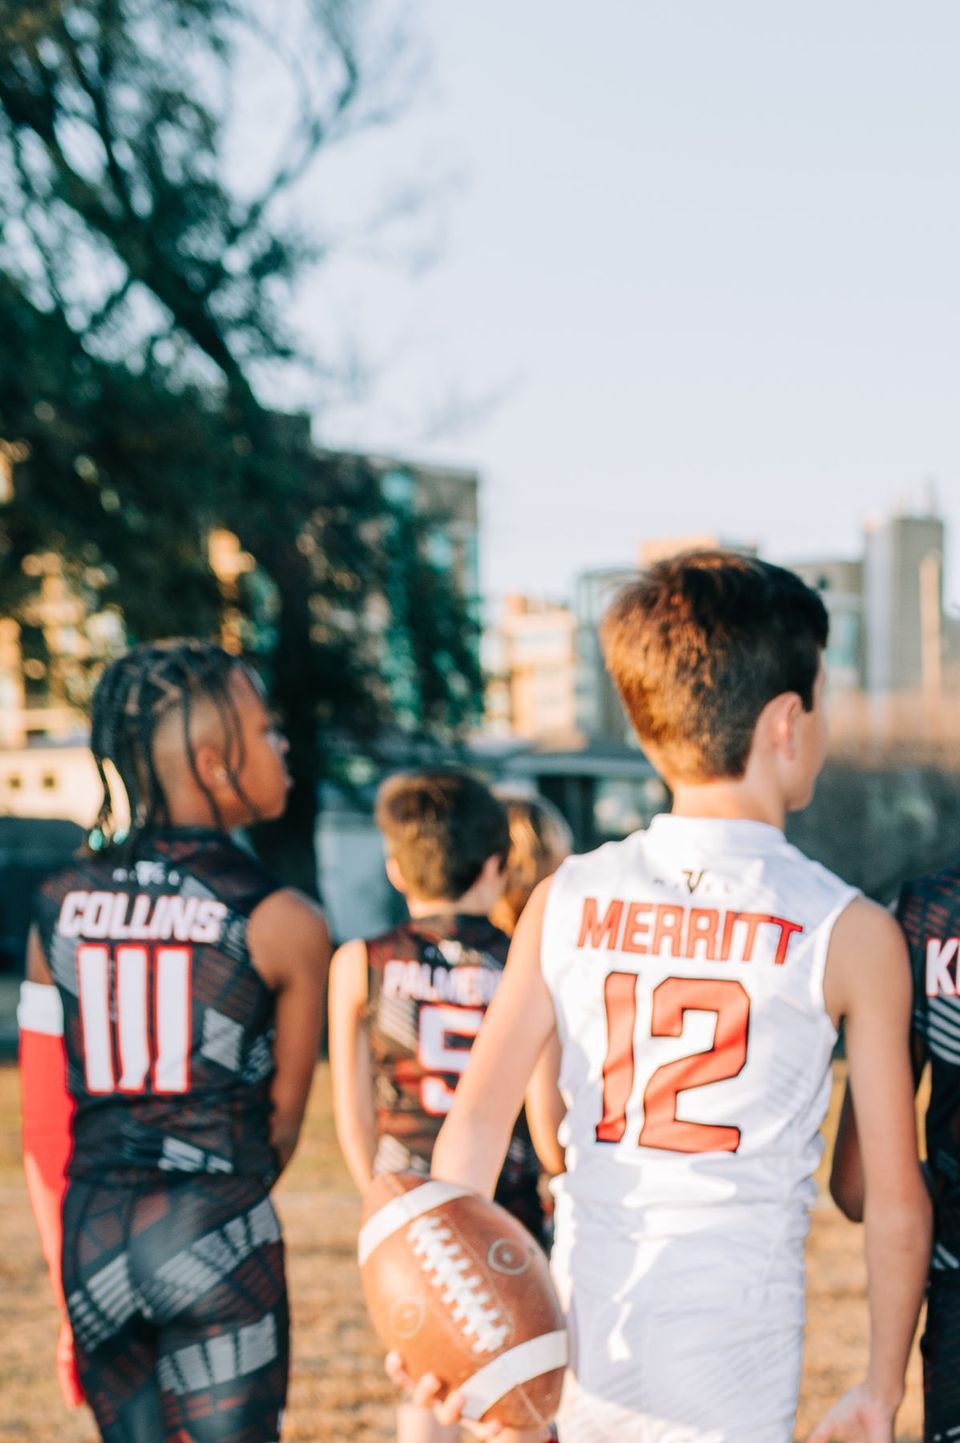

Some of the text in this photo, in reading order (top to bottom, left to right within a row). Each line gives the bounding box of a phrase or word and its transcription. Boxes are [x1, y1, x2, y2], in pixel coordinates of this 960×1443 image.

[56, 889, 229, 943] COLLINS
[576, 897, 804, 965] MERRITT
[595, 970, 751, 1154] 12
